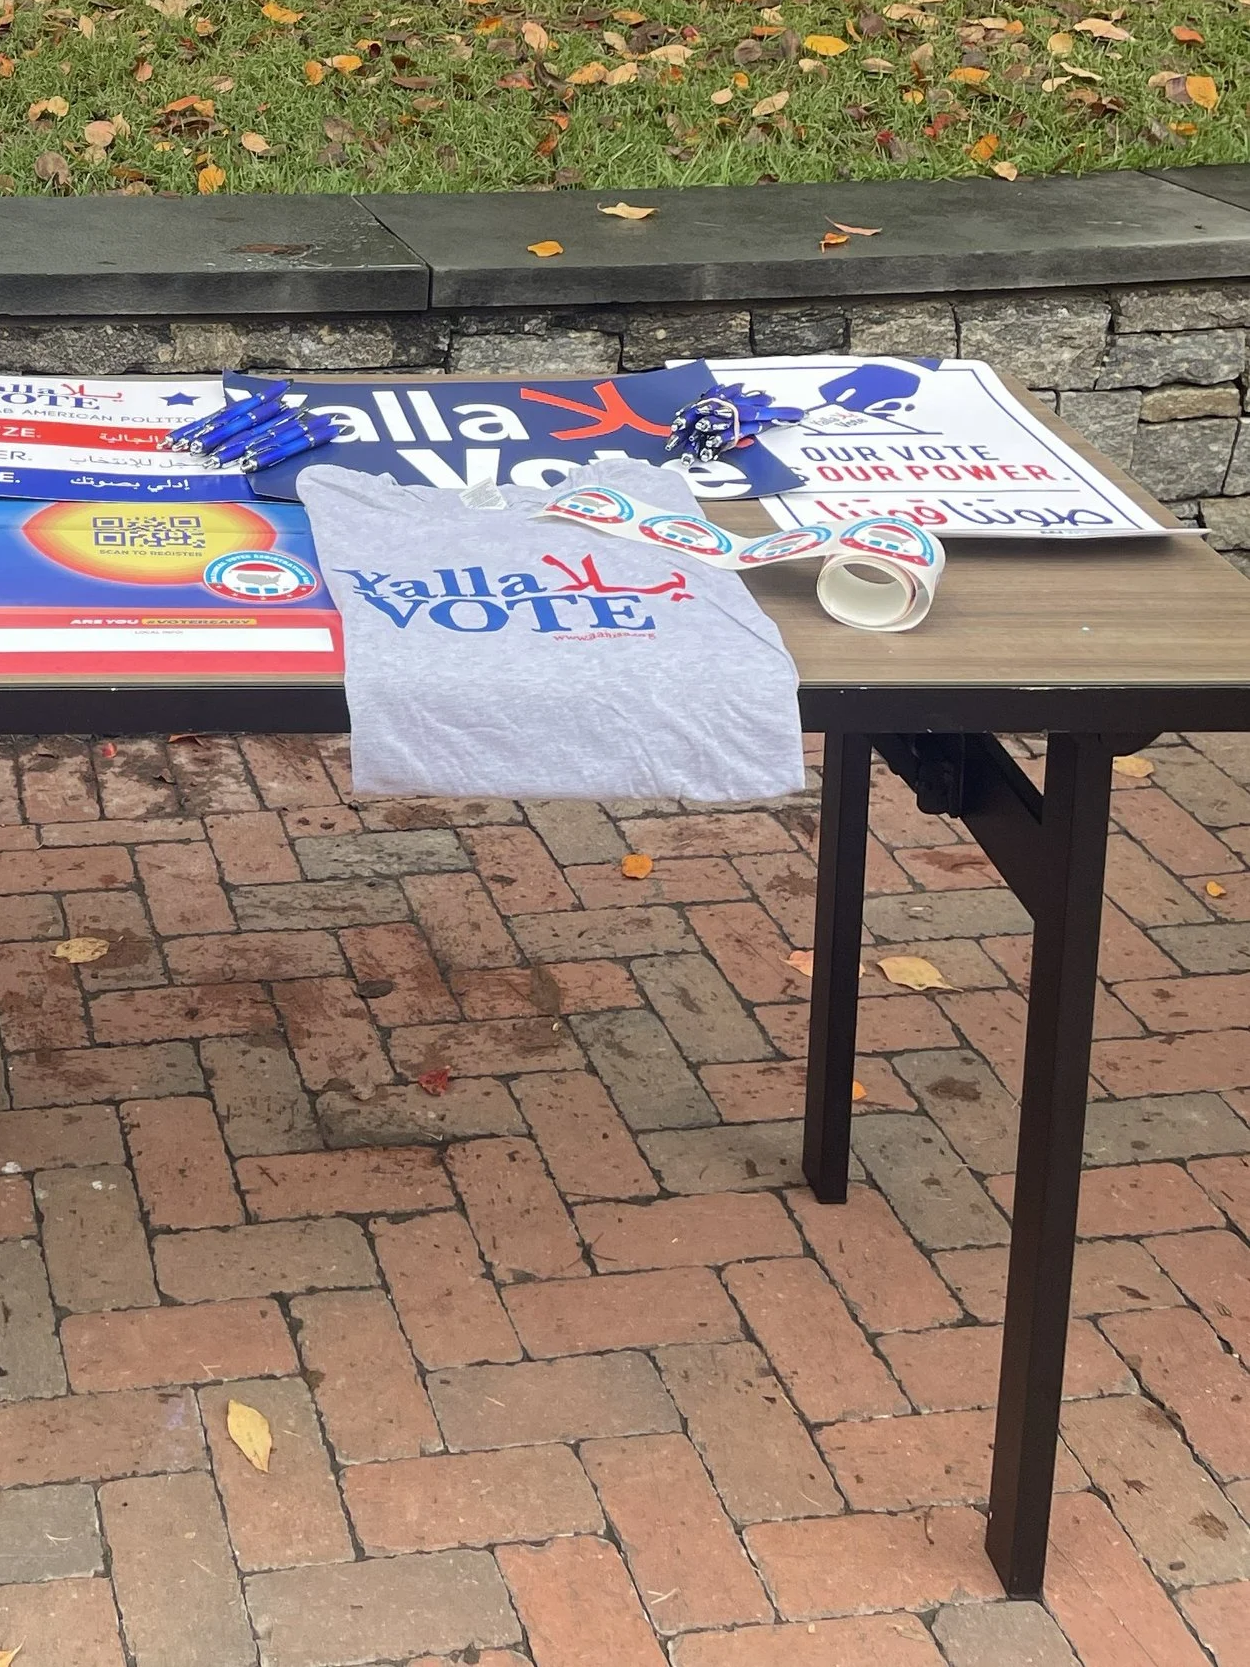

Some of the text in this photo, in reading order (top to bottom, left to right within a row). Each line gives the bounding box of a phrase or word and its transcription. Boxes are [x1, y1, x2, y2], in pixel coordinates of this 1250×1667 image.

[21, 409, 113, 422] AMERICAN
[800, 444, 1000, 462] OUR VOTE
[398, 448, 752, 498] Voe
[816, 465, 903, 482] OUR
[905, 464, 1072, 482] POWER.
[332, 566, 548, 600] Yalla
[352, 591, 657, 633] VOTE
